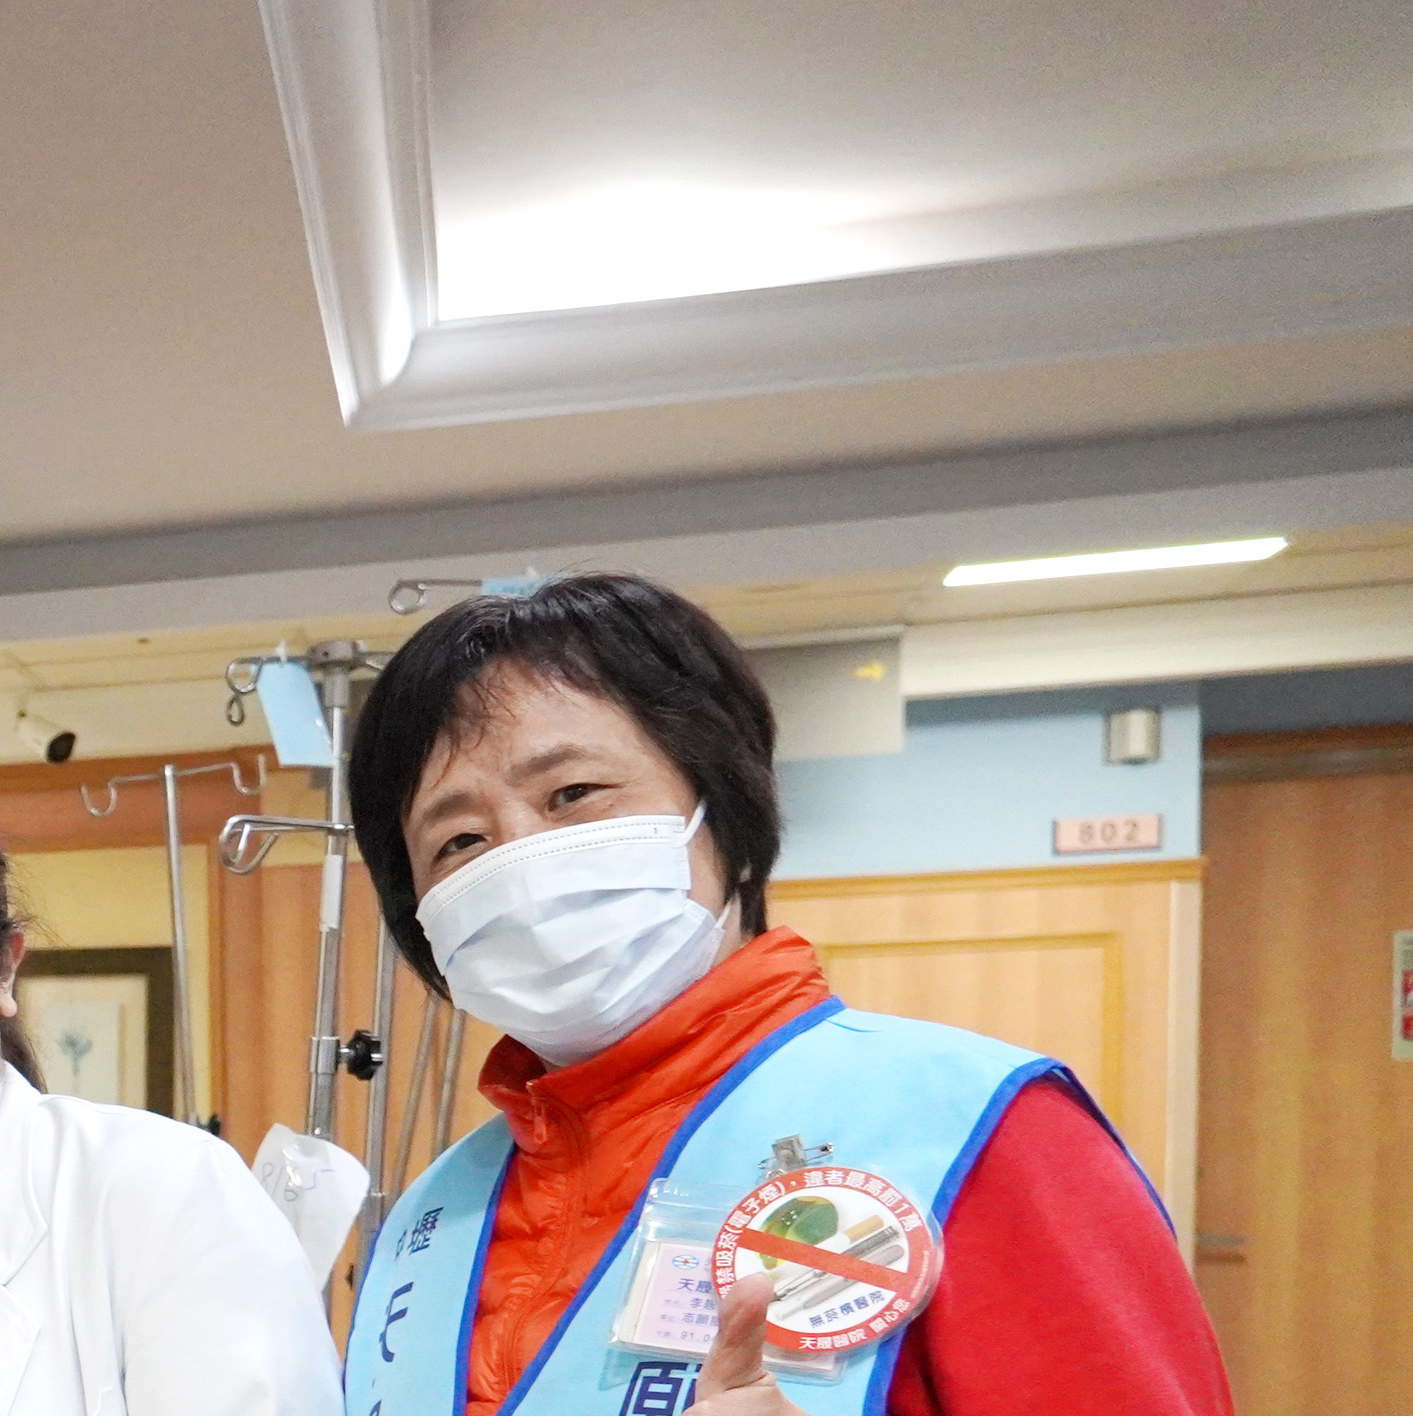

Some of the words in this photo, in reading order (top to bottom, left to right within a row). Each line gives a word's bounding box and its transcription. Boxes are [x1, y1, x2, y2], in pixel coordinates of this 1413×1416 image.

[799, 1328, 868, 1350] 天晟醫院
[869, 1298, 912, 1333] 關心您
[809, 1290, 887, 1329] 無菸檳醫院
